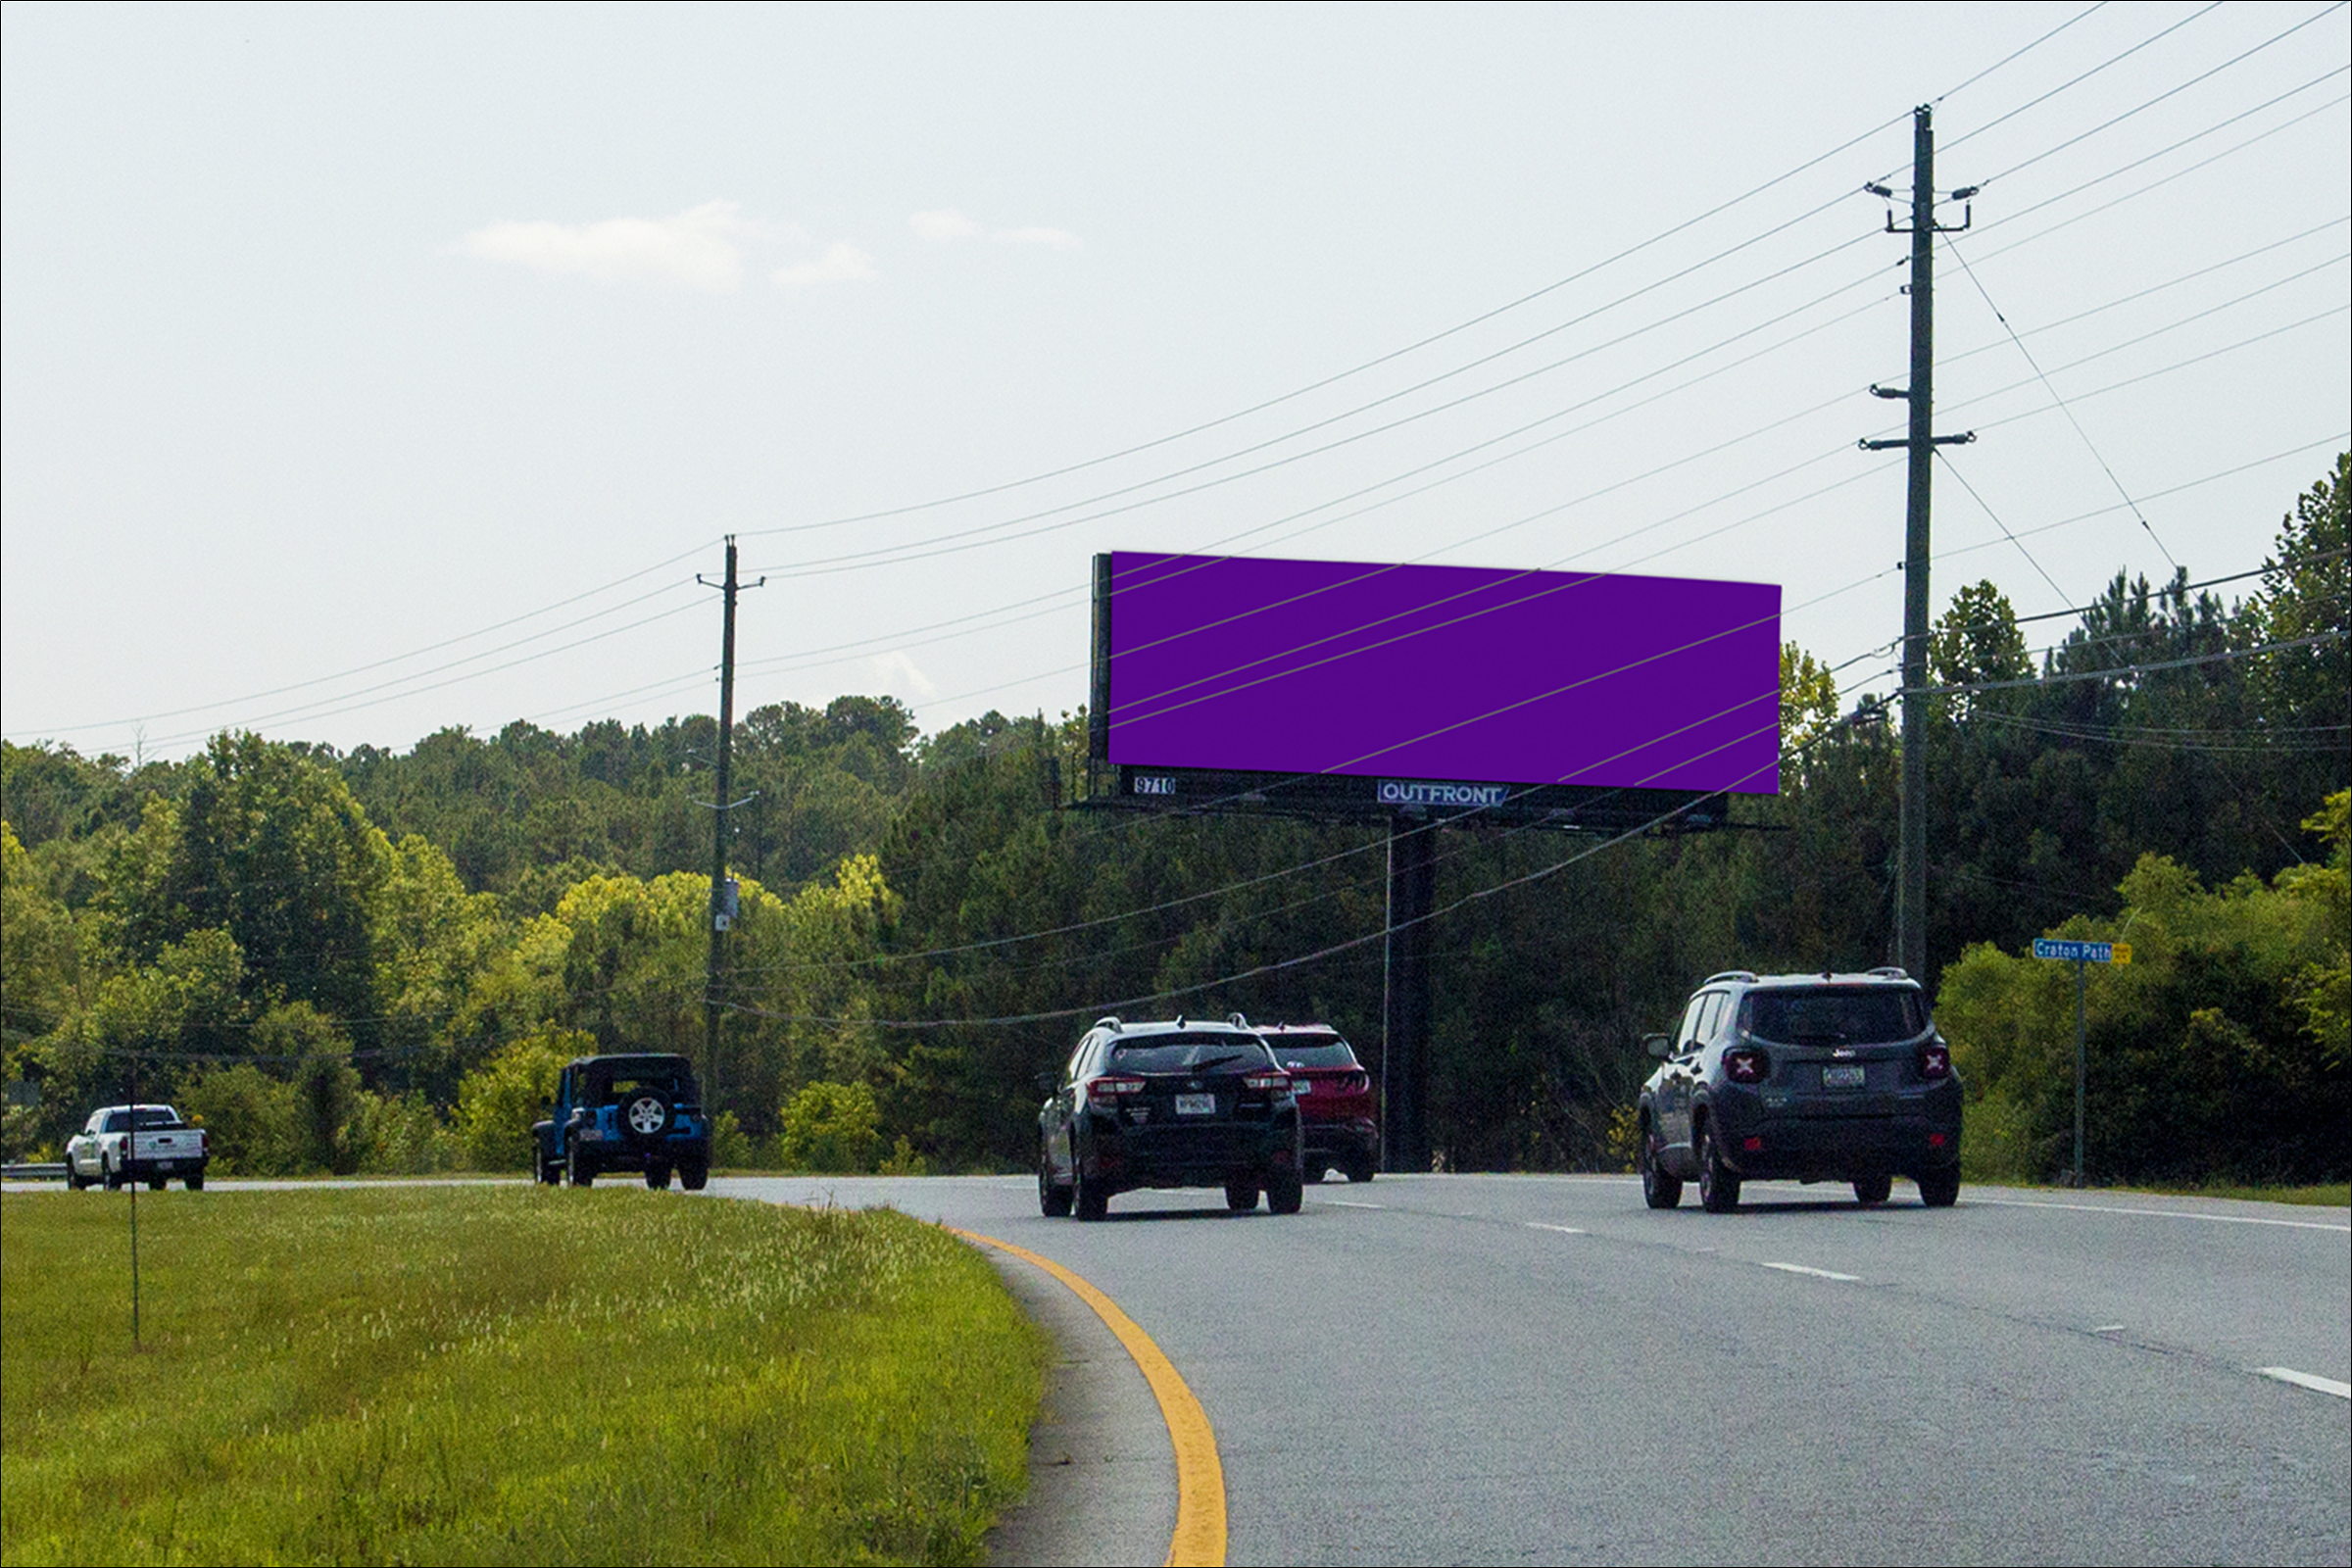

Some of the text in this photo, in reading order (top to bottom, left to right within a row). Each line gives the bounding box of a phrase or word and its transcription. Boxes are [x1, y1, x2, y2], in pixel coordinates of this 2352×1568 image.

[1136, 777, 1174, 793] 9710
[1383, 783, 1502, 804] OUTFRONT
[2036, 942, 2079, 956] Craton
[2082, 944, 2112, 958] Path
